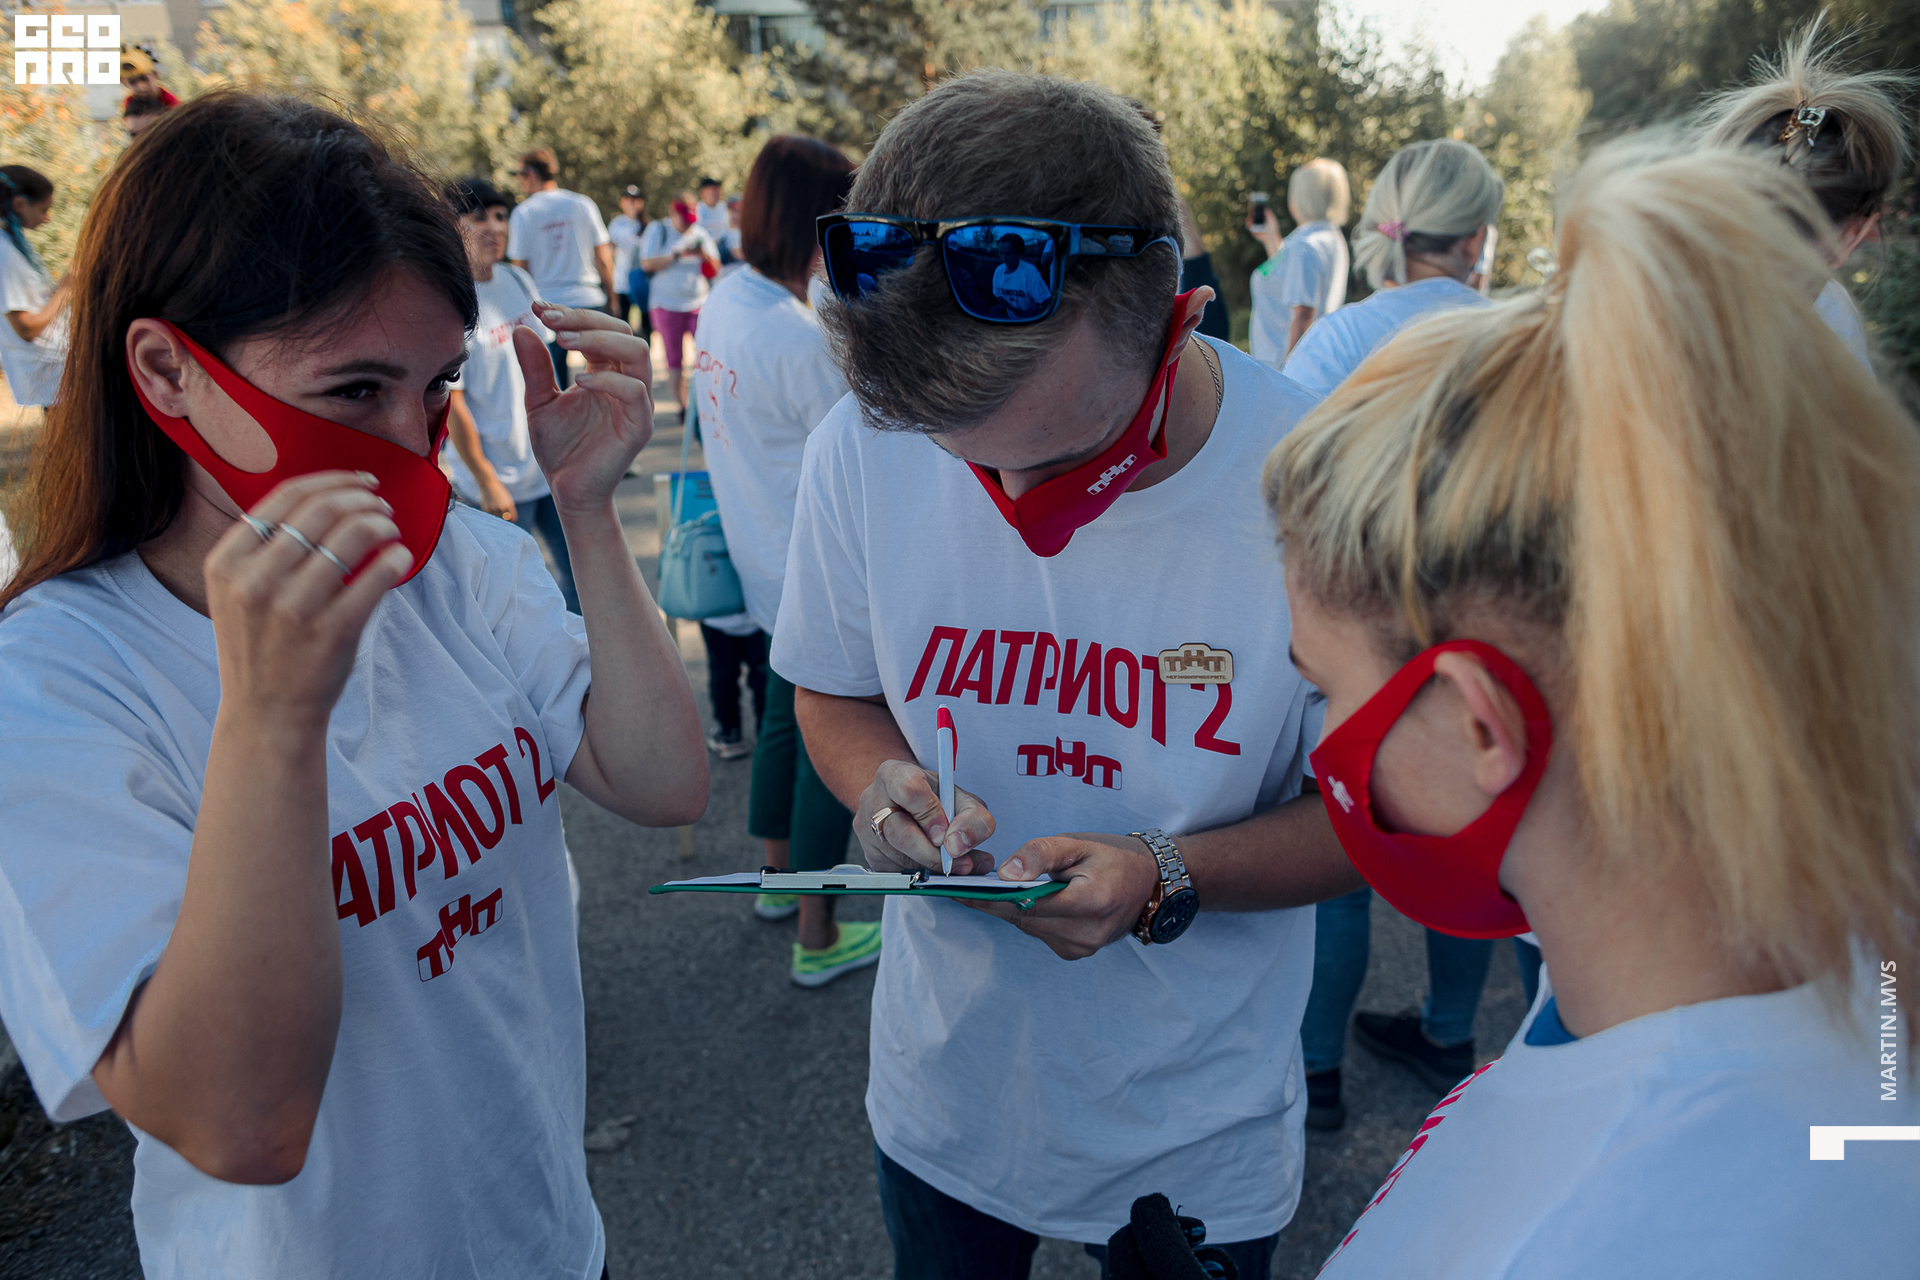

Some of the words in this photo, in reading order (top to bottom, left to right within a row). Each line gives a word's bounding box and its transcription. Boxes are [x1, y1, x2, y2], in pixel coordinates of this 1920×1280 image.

[904, 625, 1166, 748] ПАТРИОТ
[1190, 684, 1242, 756] 2
[331, 742, 523, 928] АТРИОТ
[514, 726, 556, 806] 2
